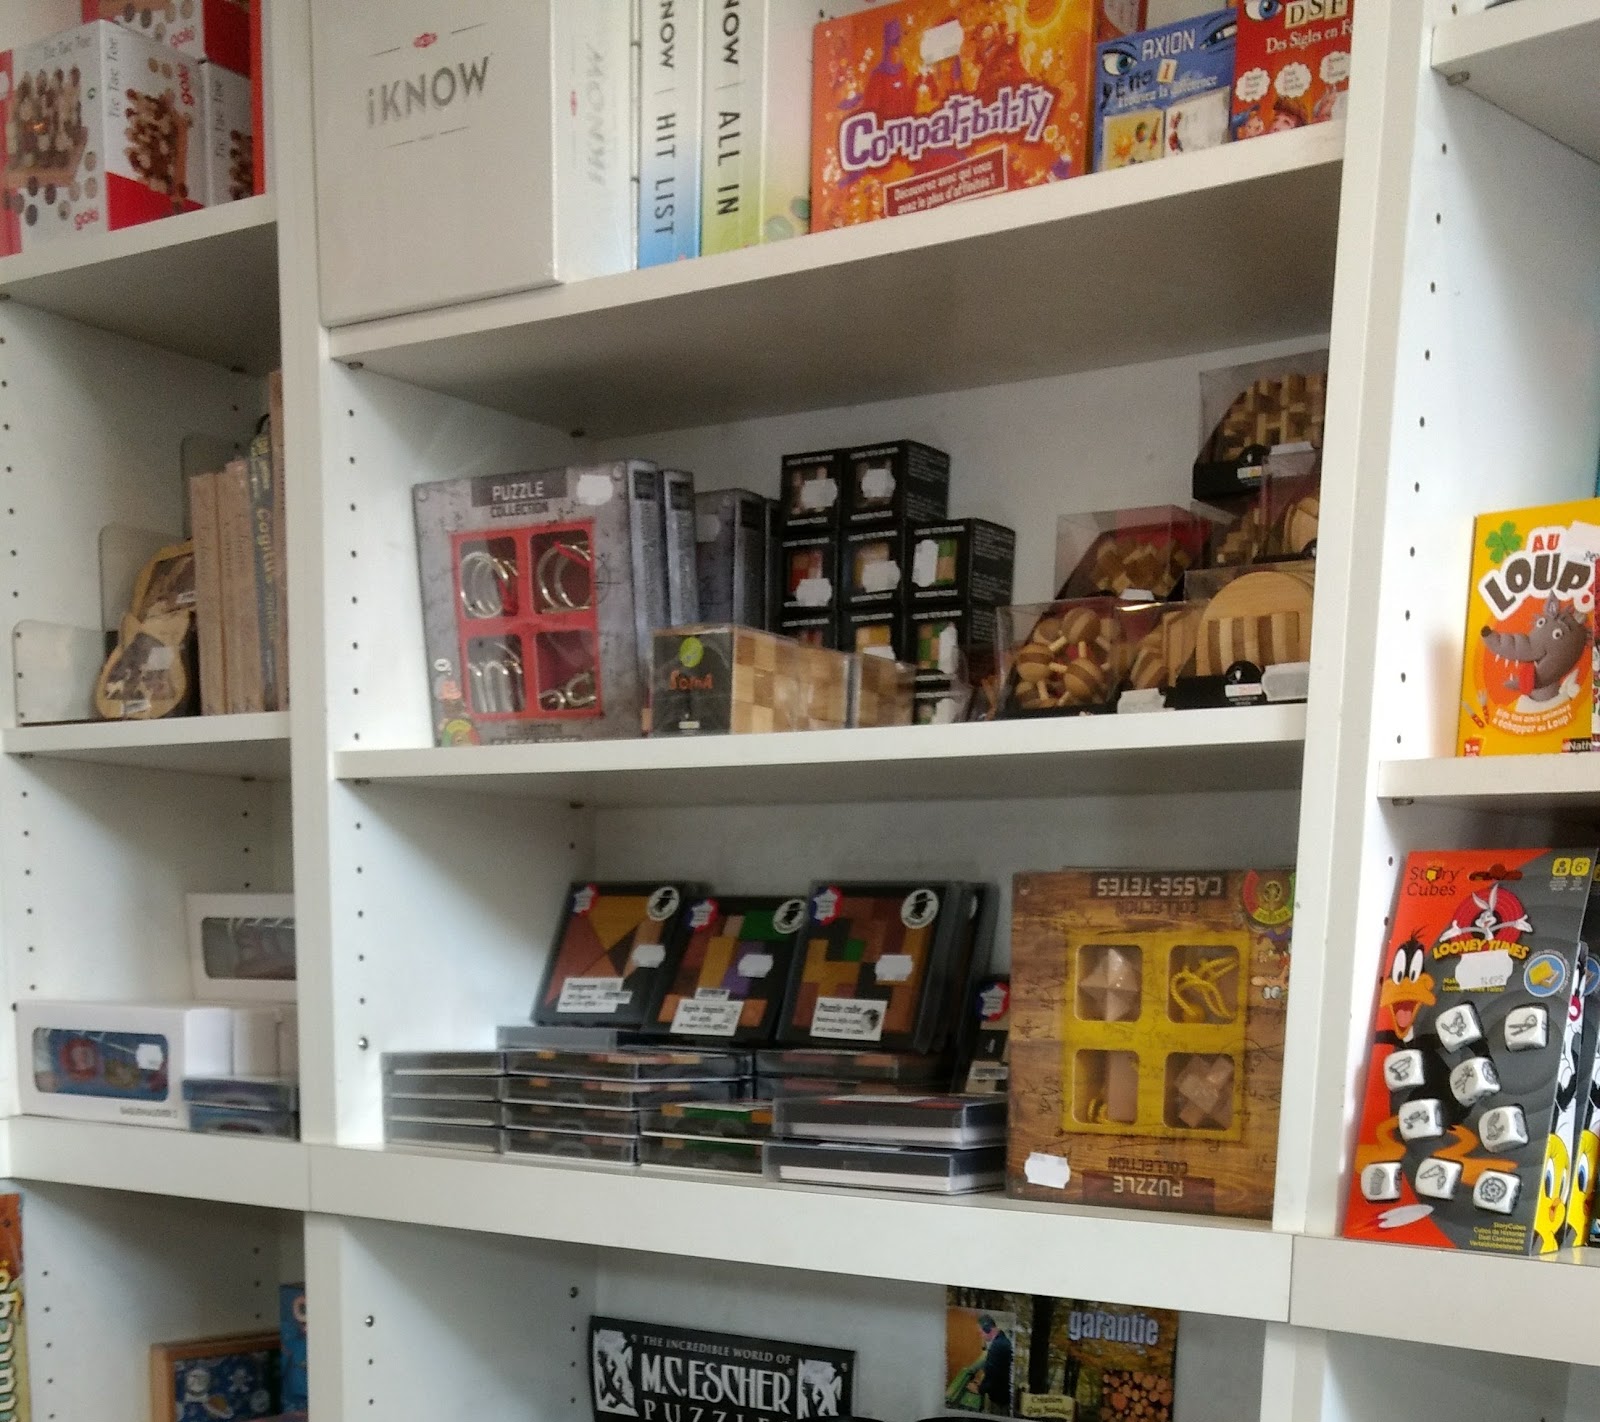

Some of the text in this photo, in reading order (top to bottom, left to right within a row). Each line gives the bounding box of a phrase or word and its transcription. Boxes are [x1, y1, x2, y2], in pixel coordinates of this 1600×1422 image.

[1141, 29, 1196, 61] AXION
[1266, 27, 1338, 53] Des Sigles en
[842, 86, 1053, 168] Compatibility
[654, 112, 675, 236] HIT LIST
[716, 110, 741, 216] ALL IN
[492, 481, 544, 500] PUZZLE
[1532, 533, 1560, 553] AU
[1096, 876, 1222, 897] CASSE-TETES
[1407, 882, 1456, 897] Cubes
[1433, 939, 1487, 960] LOONEY
[1112, 1175, 1185, 1198] PUZZLE
[1069, 1311, 1159, 1346] garantie
[643, 1335, 792, 1365] THE INCREDIBLE WORLD OF
